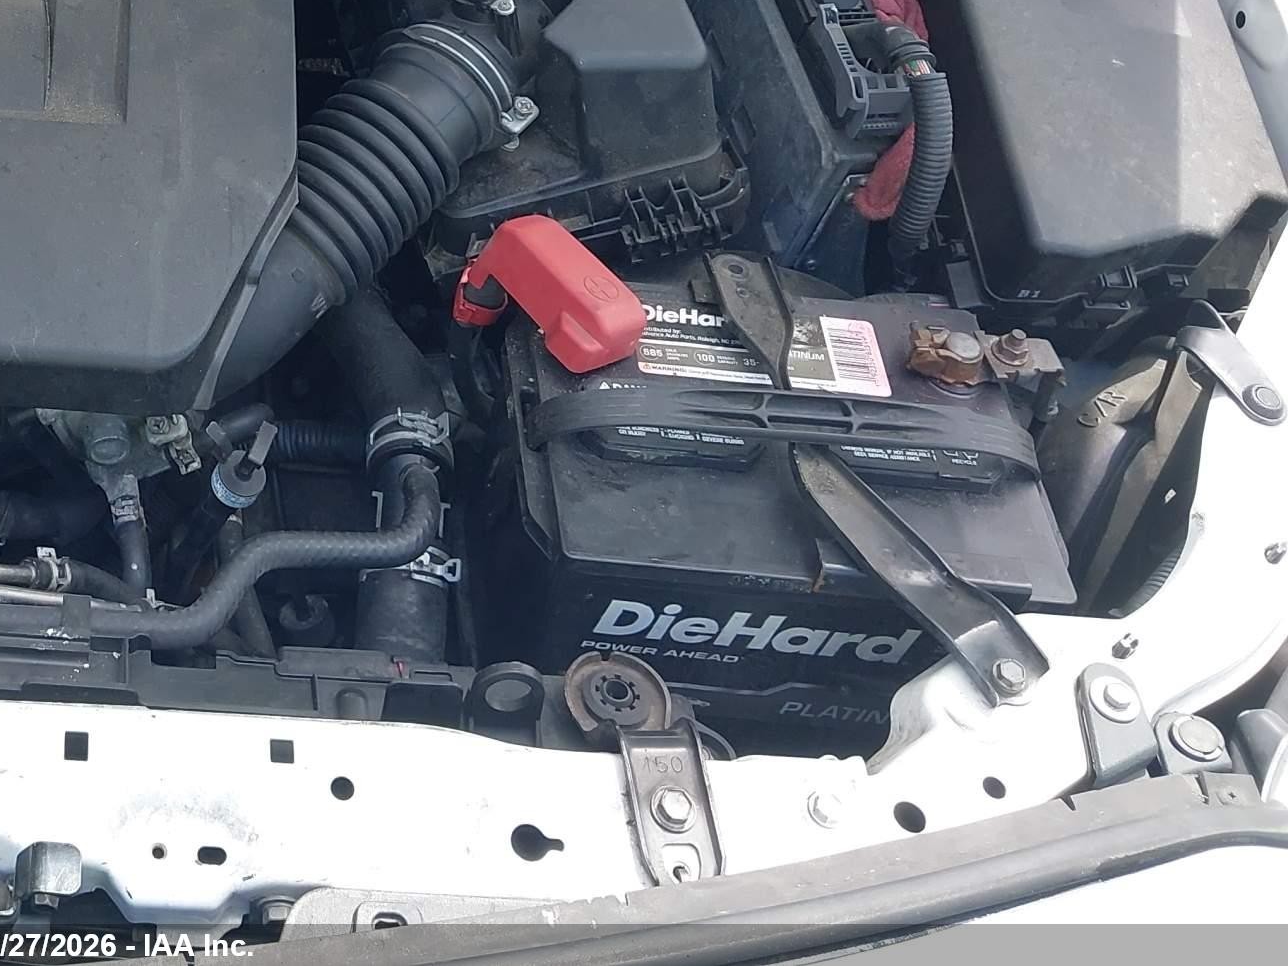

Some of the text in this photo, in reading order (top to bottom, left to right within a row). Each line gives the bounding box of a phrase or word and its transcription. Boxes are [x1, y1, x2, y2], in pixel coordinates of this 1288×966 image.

[642, 303, 727, 327] DieHar
[696, 352, 716, 363] 100
[1077, 391, 1128, 428] C/R
[592, 599, 923, 665] DieHard
[580, 640, 740, 664] POWER AHEAD
[779, 701, 890, 725] PLATIN
[642, 754, 682, 774] 150
